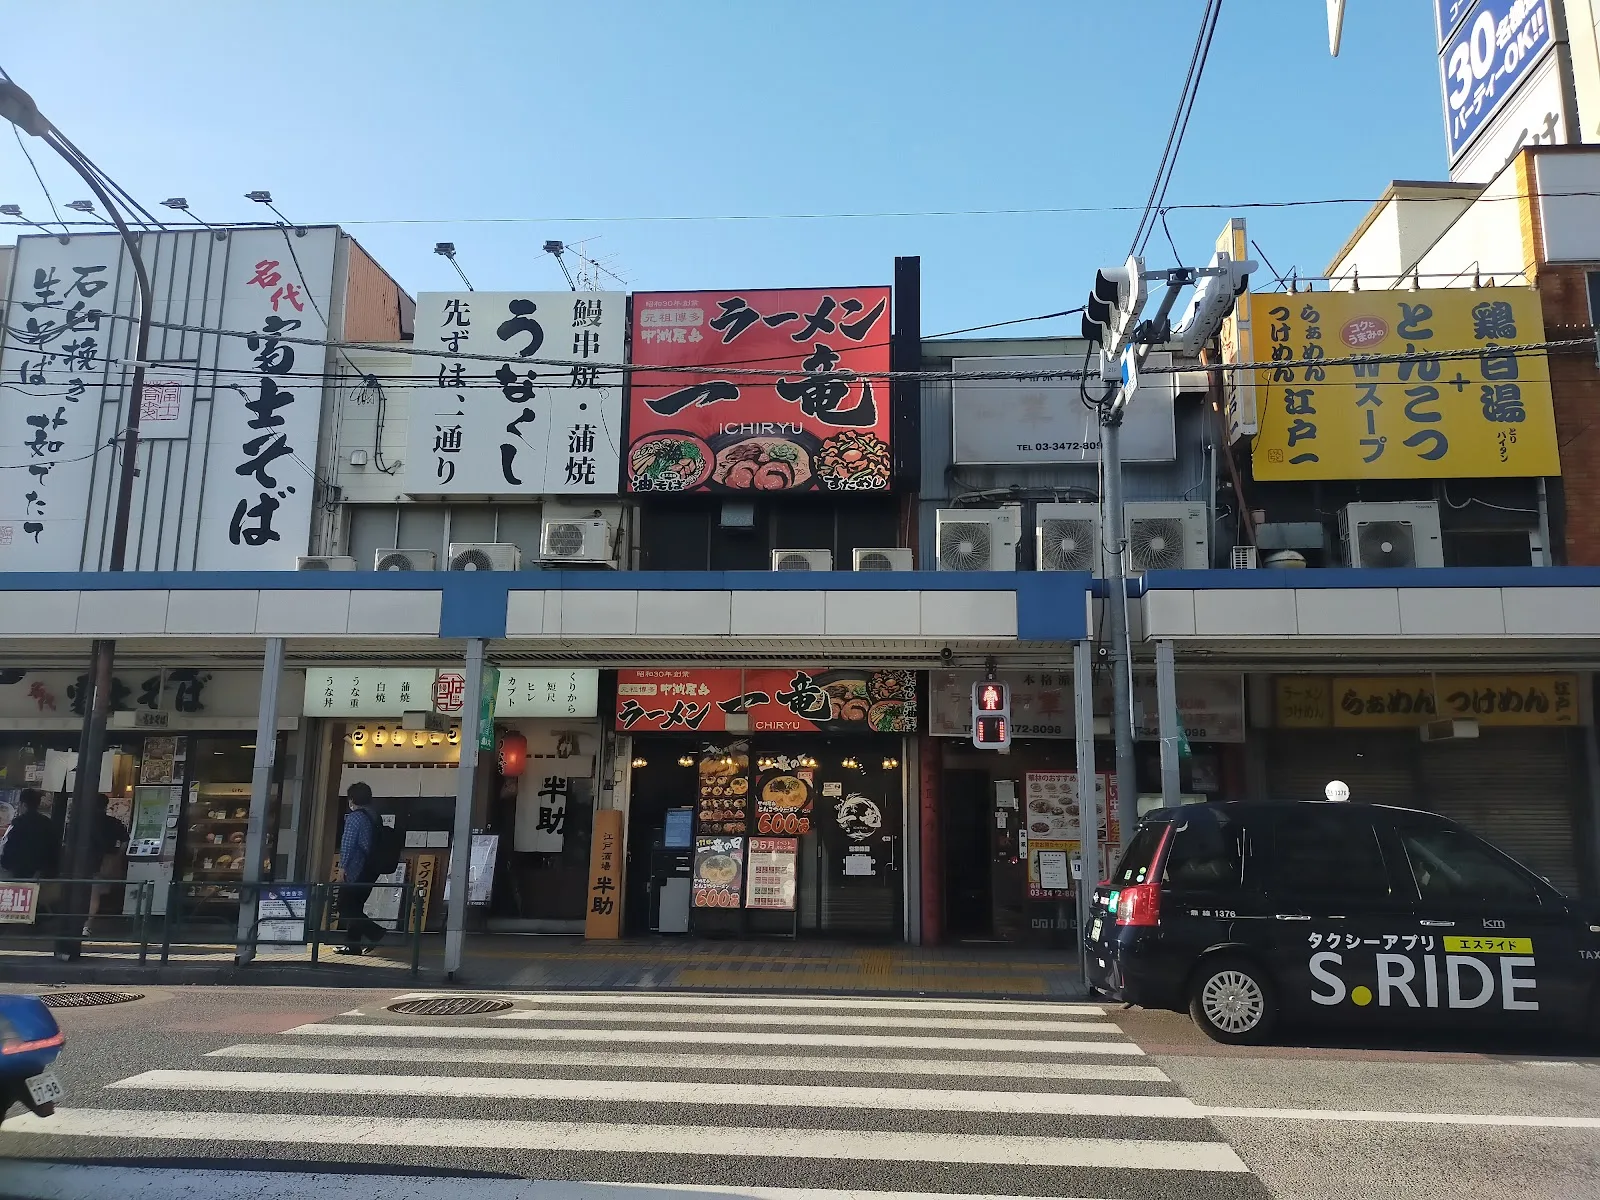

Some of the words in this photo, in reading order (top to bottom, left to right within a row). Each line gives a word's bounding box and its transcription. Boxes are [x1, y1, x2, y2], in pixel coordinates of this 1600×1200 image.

[1454, 6, 1545, 139] パーティーOK!!
[246, 260, 304, 312] 名代
[708, 295, 887, 344] ラーメン
[1348, 330, 1384, 345] うまみの
[1350, 321, 1375, 333] コクと
[1268, 306, 1294, 383] つけめん
[1472, 302, 1526, 423] 鶏白湯
[496, 298, 544, 485] うなくし
[643, 343, 878, 427] 一竜
[1397, 302, 1449, 460] とんこつ
[229, 316, 301, 546] 富士そば
[719, 422, 803, 435] ICHIRYU
[1035, 442, 1103, 451] 03-3472-809
[1284, 388, 1320, 465] 江戸一
[1509, 428, 1517, 443] とり
[567, 672, 577, 714] くりから
[716, 670, 833, 722] 一竜
[1446, 687, 1549, 714] つけめん
[617, 698, 711, 730] ラーメン
[755, 721, 800, 730] CHIRYU
[1010, 724, 1062, 734] 72-8098
[536, 775, 568, 834] 半助
[0, 888, 31, 911] 禁止!
[591, 876, 615, 915] 半助
[1308, 932, 1436, 953] タクシーアプリ
[1461, 940, 1517, 950] エスライド
[1579, 950, 1600, 960] TAX
